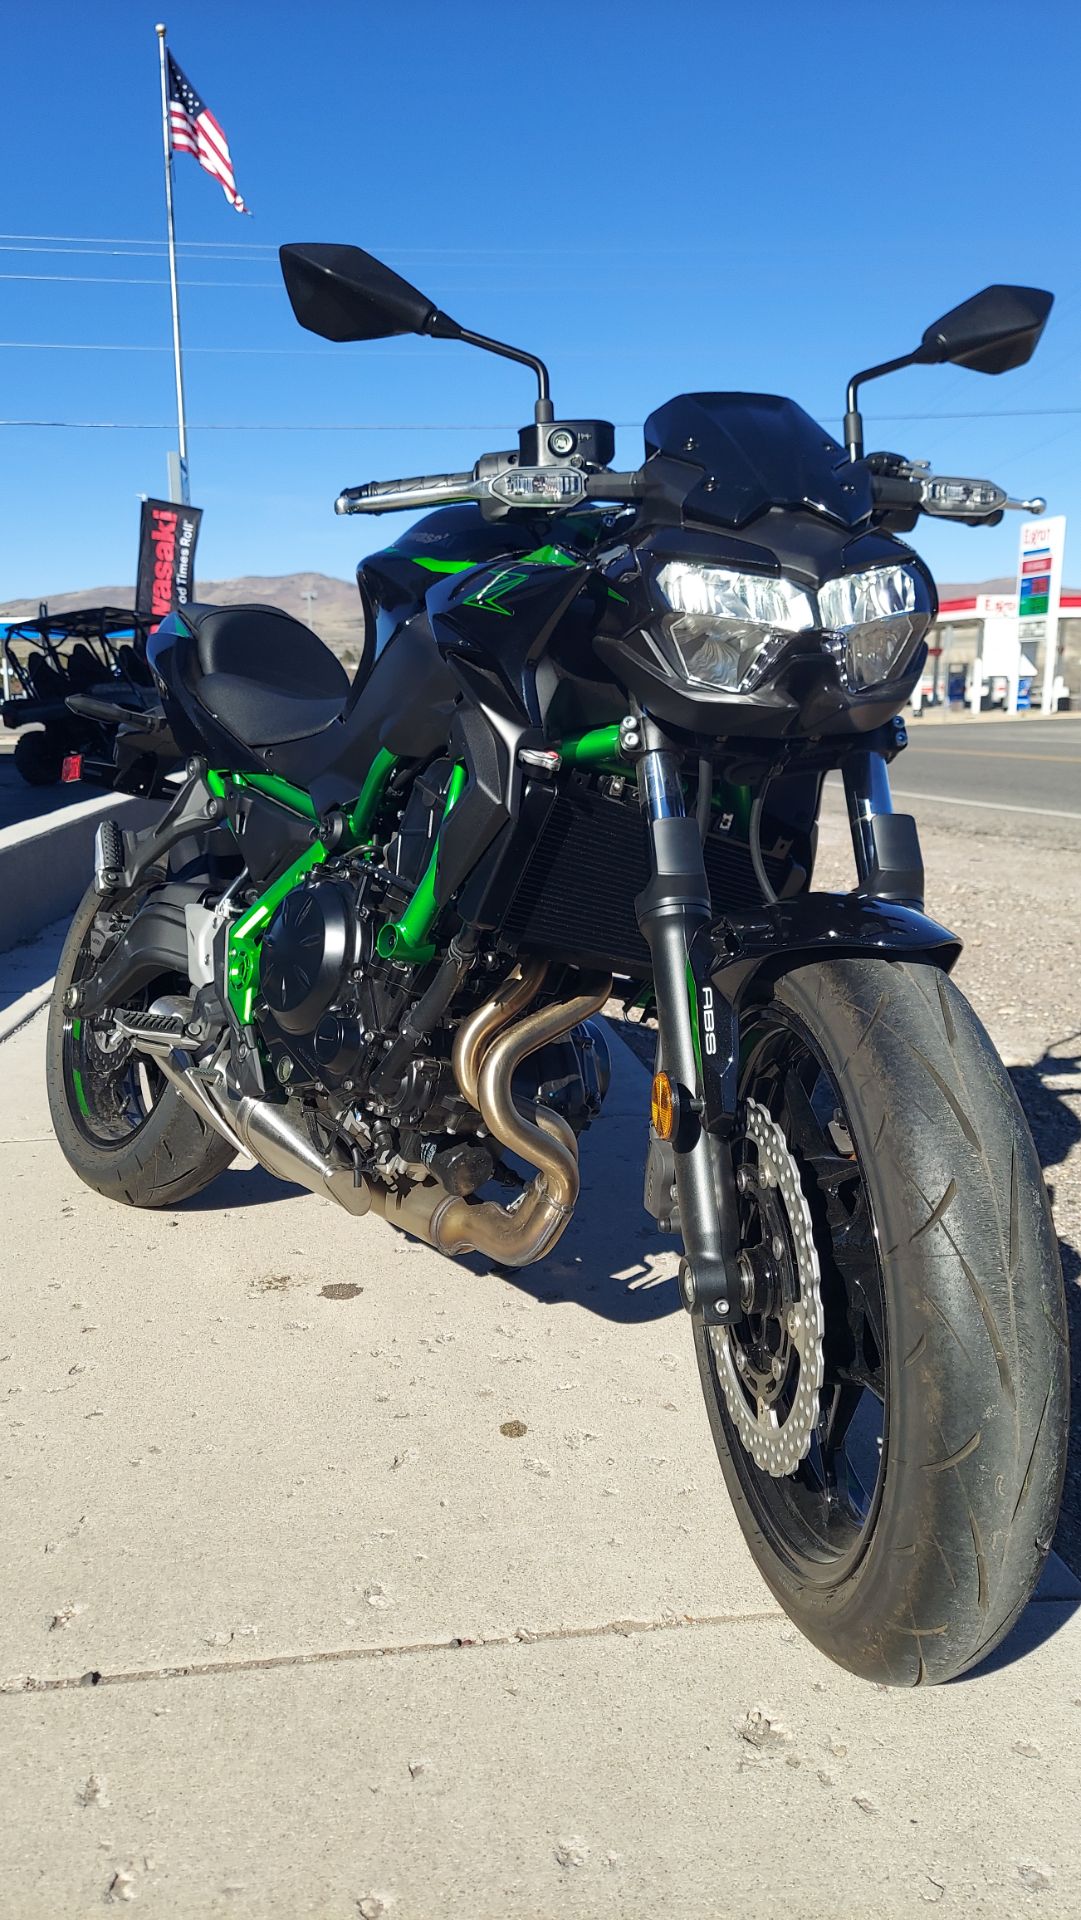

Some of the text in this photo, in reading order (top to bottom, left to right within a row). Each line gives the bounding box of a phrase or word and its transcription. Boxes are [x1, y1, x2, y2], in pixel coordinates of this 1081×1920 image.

[179, 520, 194, 548] Roll
[176, 549, 190, 585] Times
[702, 987, 716, 1055] ABS
